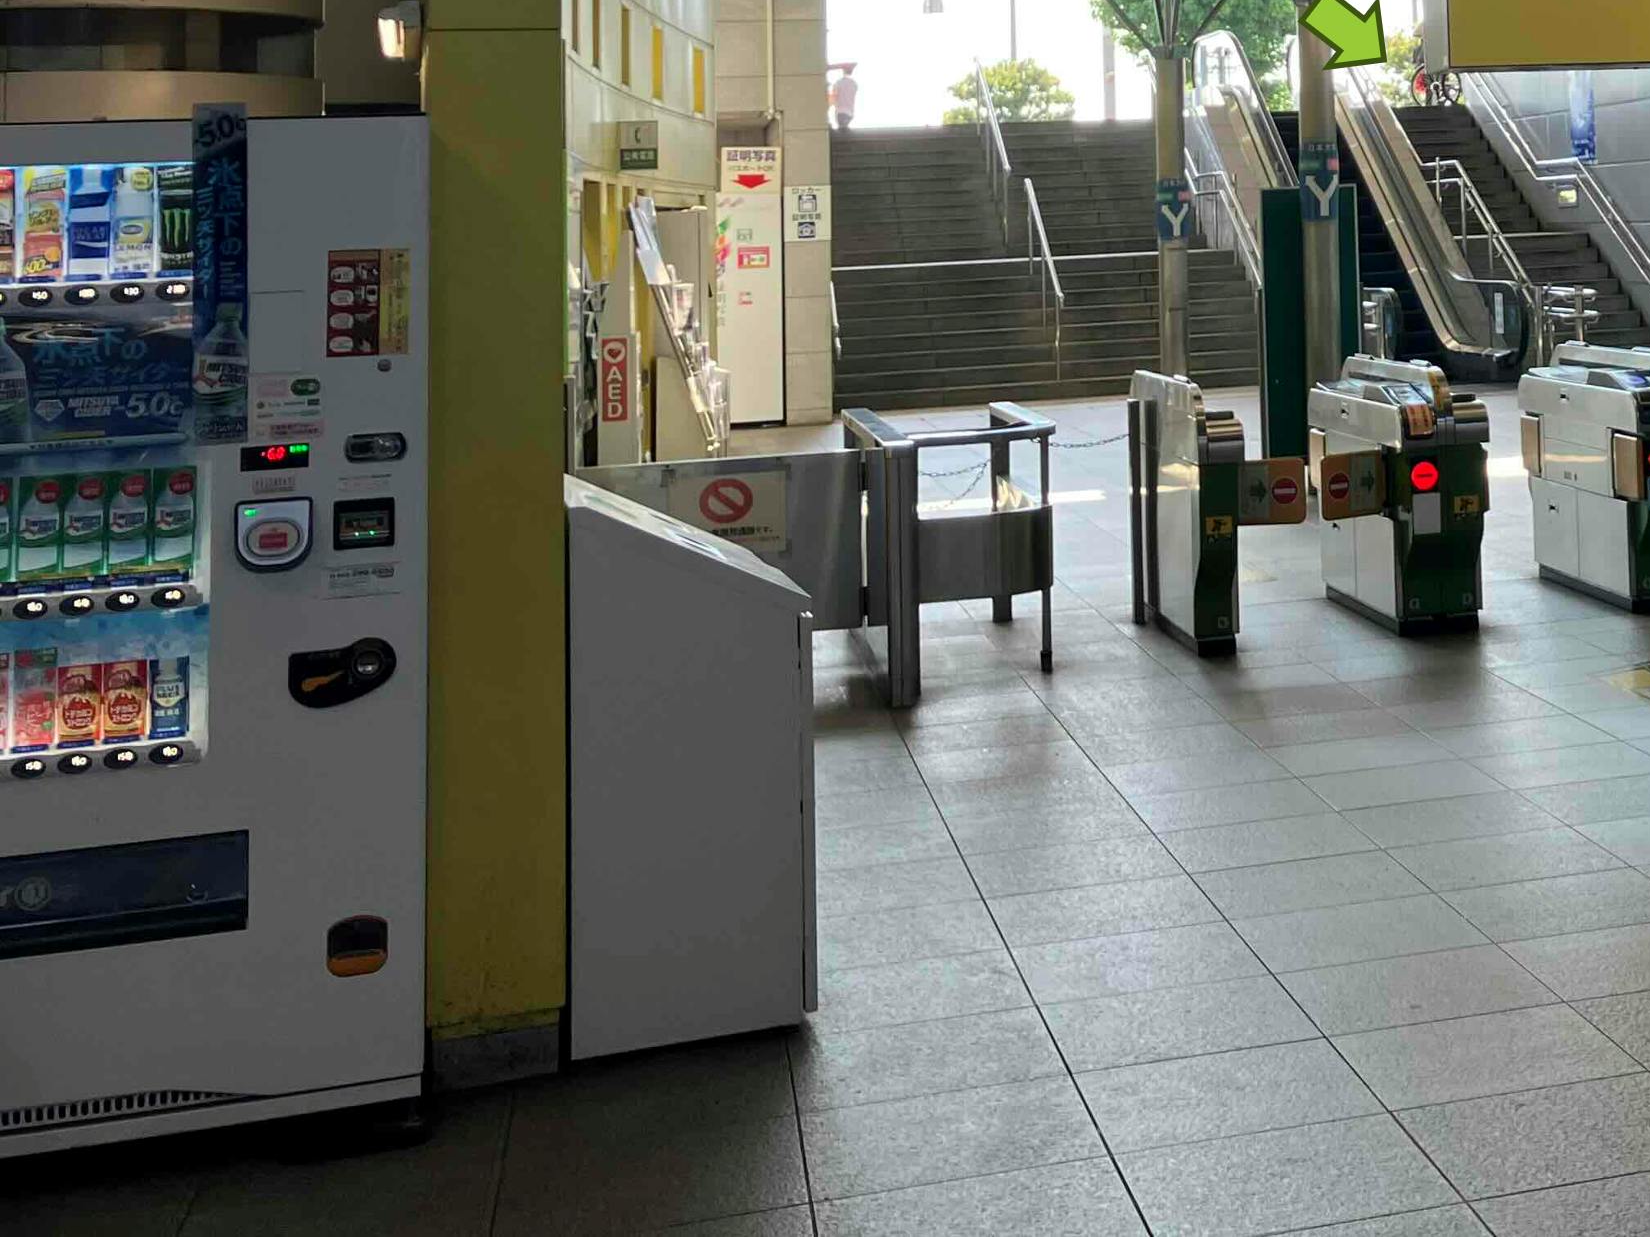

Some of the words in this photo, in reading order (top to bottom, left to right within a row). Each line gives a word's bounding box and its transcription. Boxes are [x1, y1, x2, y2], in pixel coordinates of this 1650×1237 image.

[726, 149, 777, 162] 証明写真
[606, 365, 624, 418] AED
